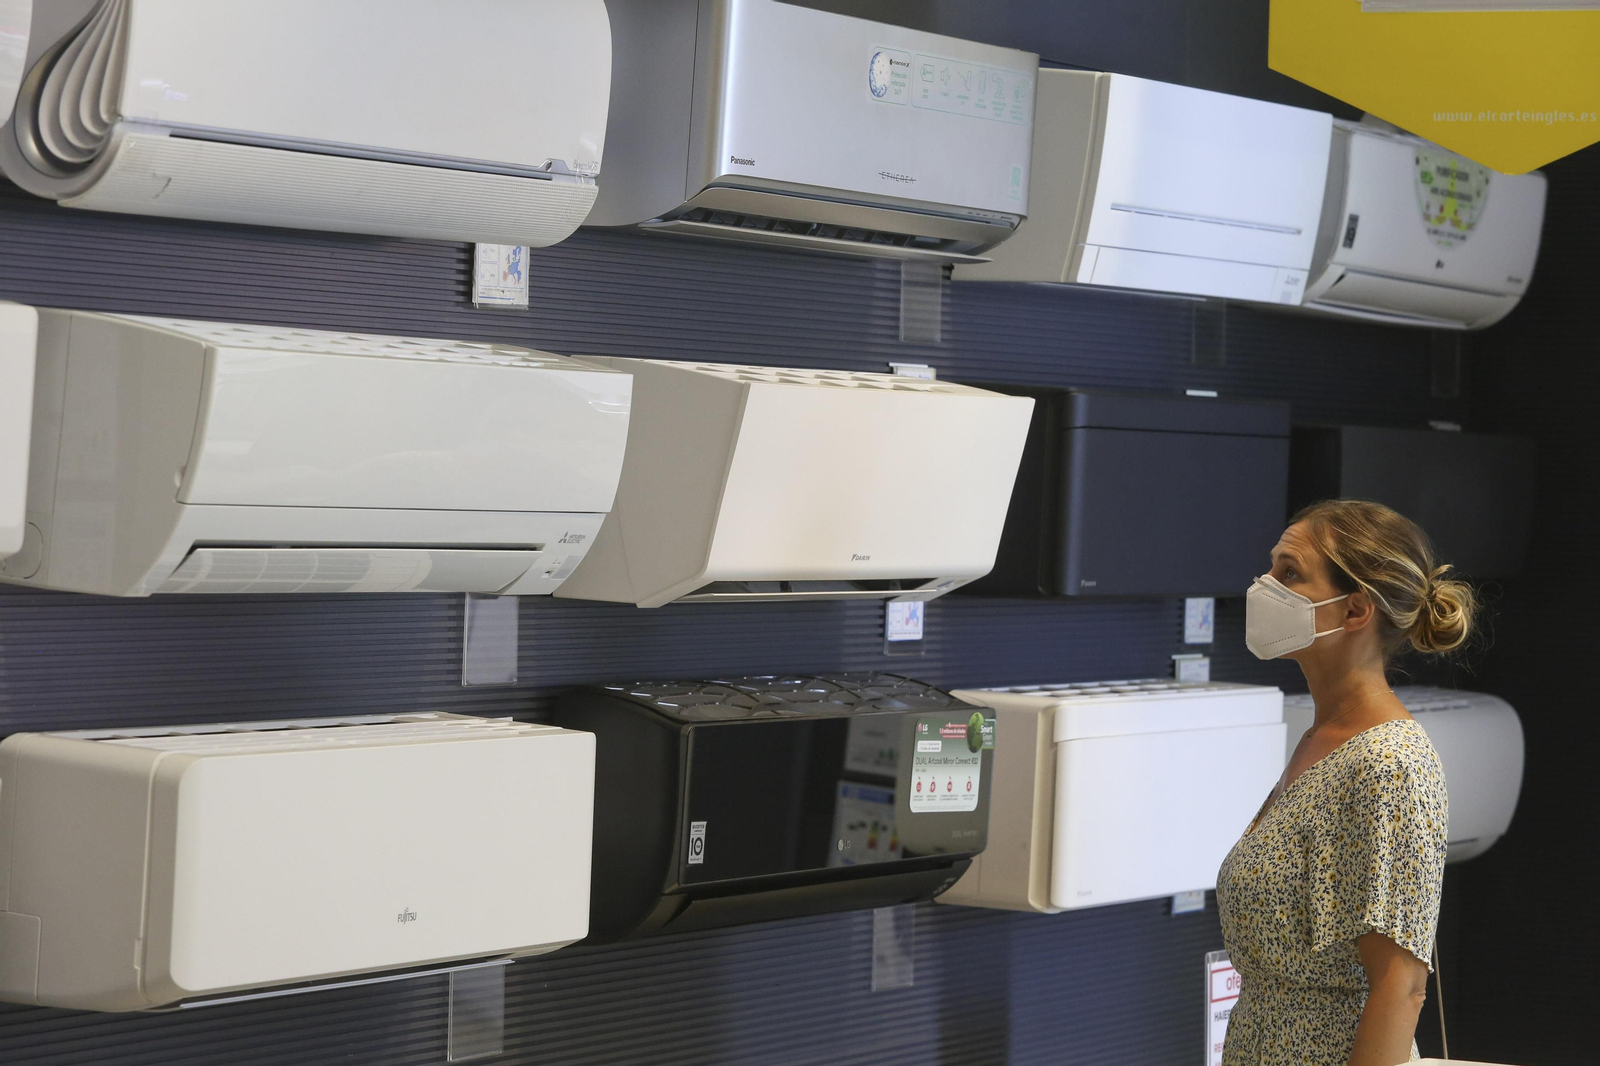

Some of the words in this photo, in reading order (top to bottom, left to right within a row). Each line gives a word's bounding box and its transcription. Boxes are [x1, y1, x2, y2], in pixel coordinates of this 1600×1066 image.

[1432, 109, 1598, 126] www.elcorteingles.es
[730, 155, 756, 167] Panasonic
[922, 724, 929, 732] LG
[980, 725, 993, 734] Smart
[915, 757, 927, 765] DUAL
[927, 757, 942, 765] Artcool
[943, 757, 954, 765] Mirror
[955, 757, 971, 765] Connect
[690, 837, 703, 856] 10
[397, 907, 418, 924] FUJITSU
